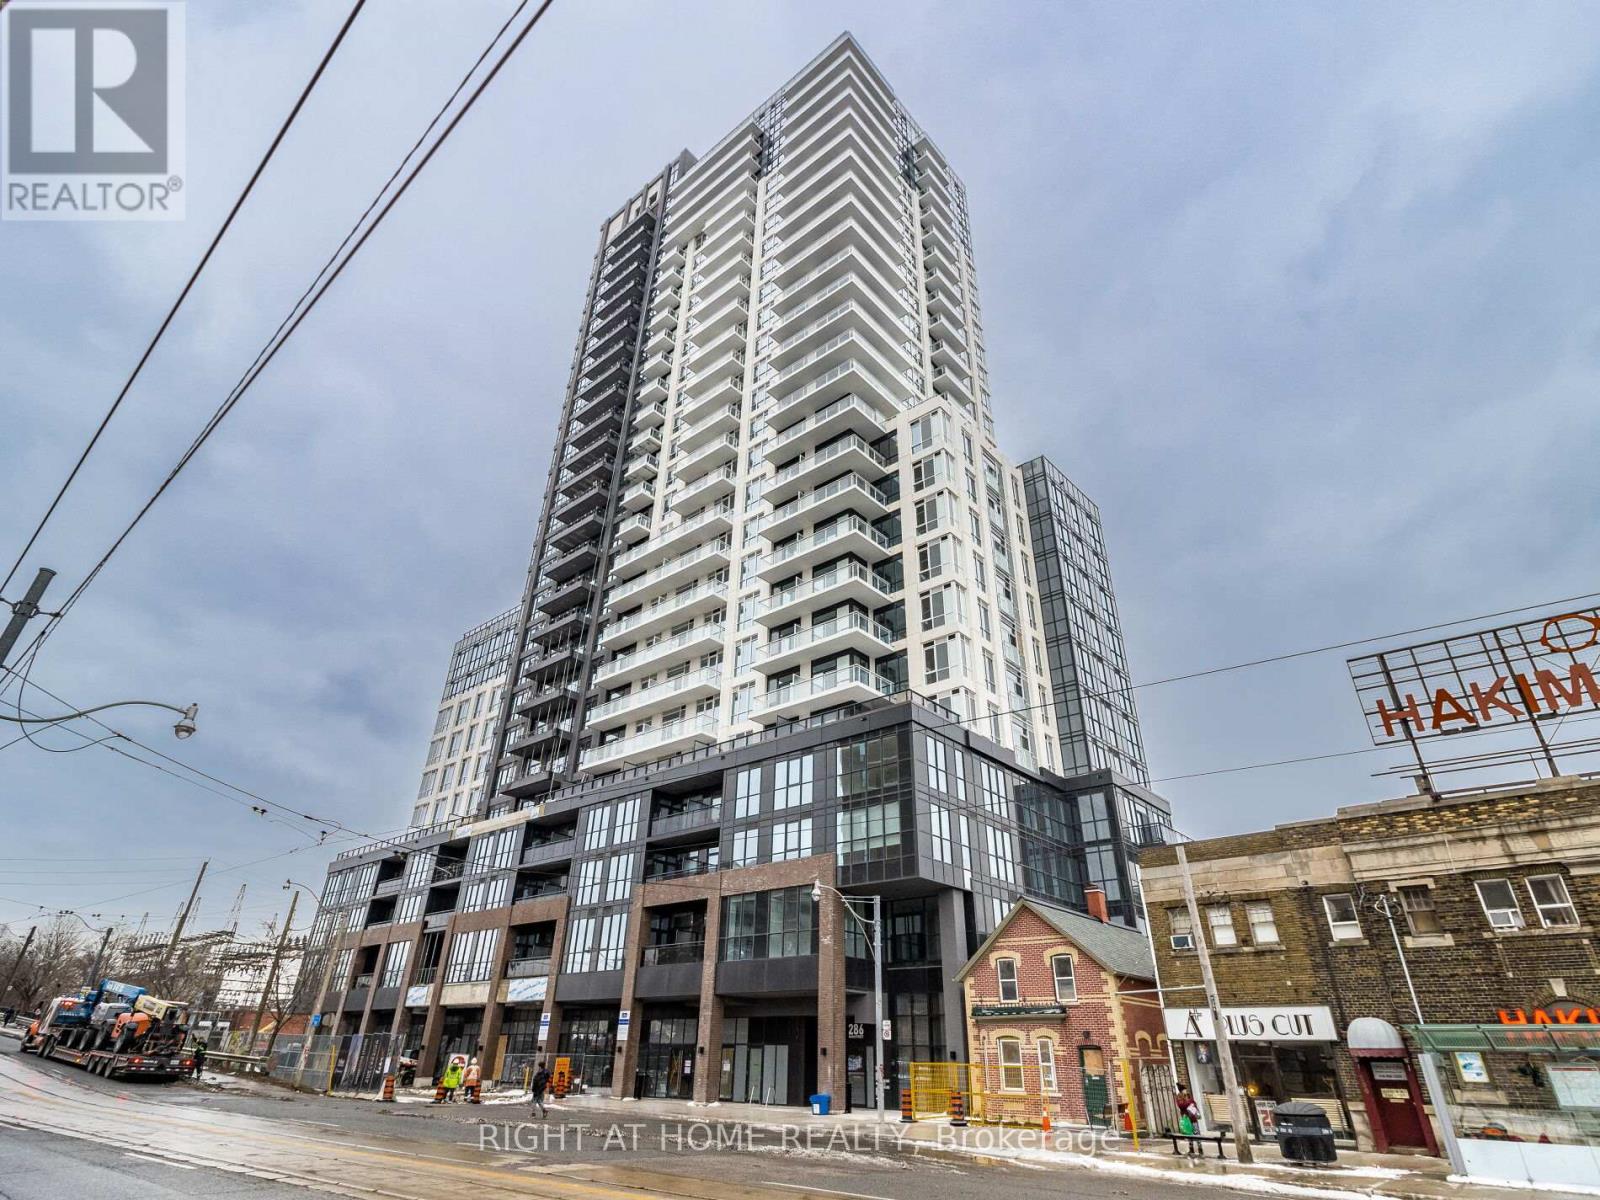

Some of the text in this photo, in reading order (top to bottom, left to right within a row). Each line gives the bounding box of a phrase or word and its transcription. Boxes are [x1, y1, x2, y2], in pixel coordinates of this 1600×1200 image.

[1376, 662, 1600, 736] HAKIM
[848, 1023, 865, 1035] 286
[1222, 1014, 1265, 1036] LUS
[1271, 1014, 1314, 1036] CUT
